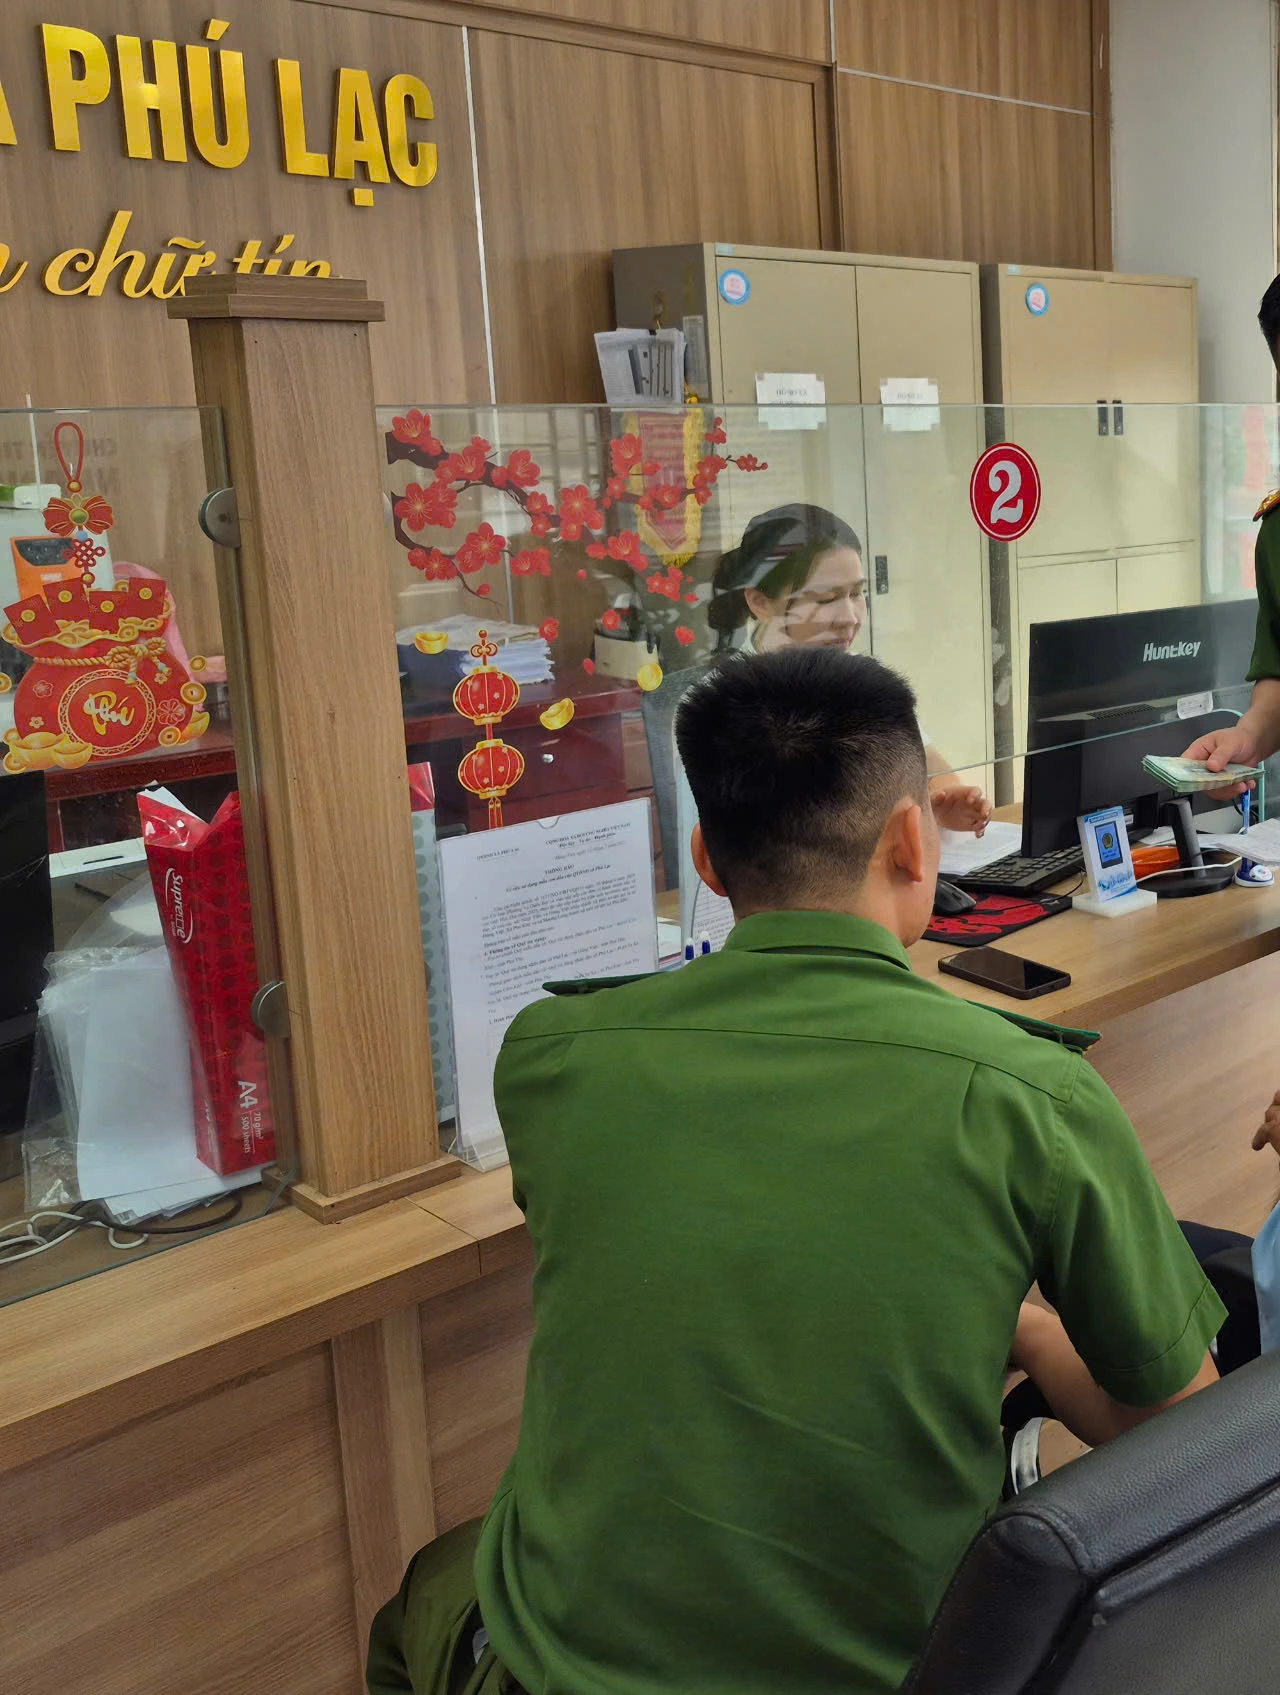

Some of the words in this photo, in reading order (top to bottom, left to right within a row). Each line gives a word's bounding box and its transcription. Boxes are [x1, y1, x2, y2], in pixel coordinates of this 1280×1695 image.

[41, 19, 251, 169] PHÚ
[274, 58, 438, 207] LẠC
[988, 460, 1024, 524] 2
[83, 690, 135, 735] Phú
[238, 1081, 258, 1109] A4
[241, 1116, 250, 1130] 500
[254, 1112, 262, 1121] 70
[243, 1132, 252, 1154] sheets
